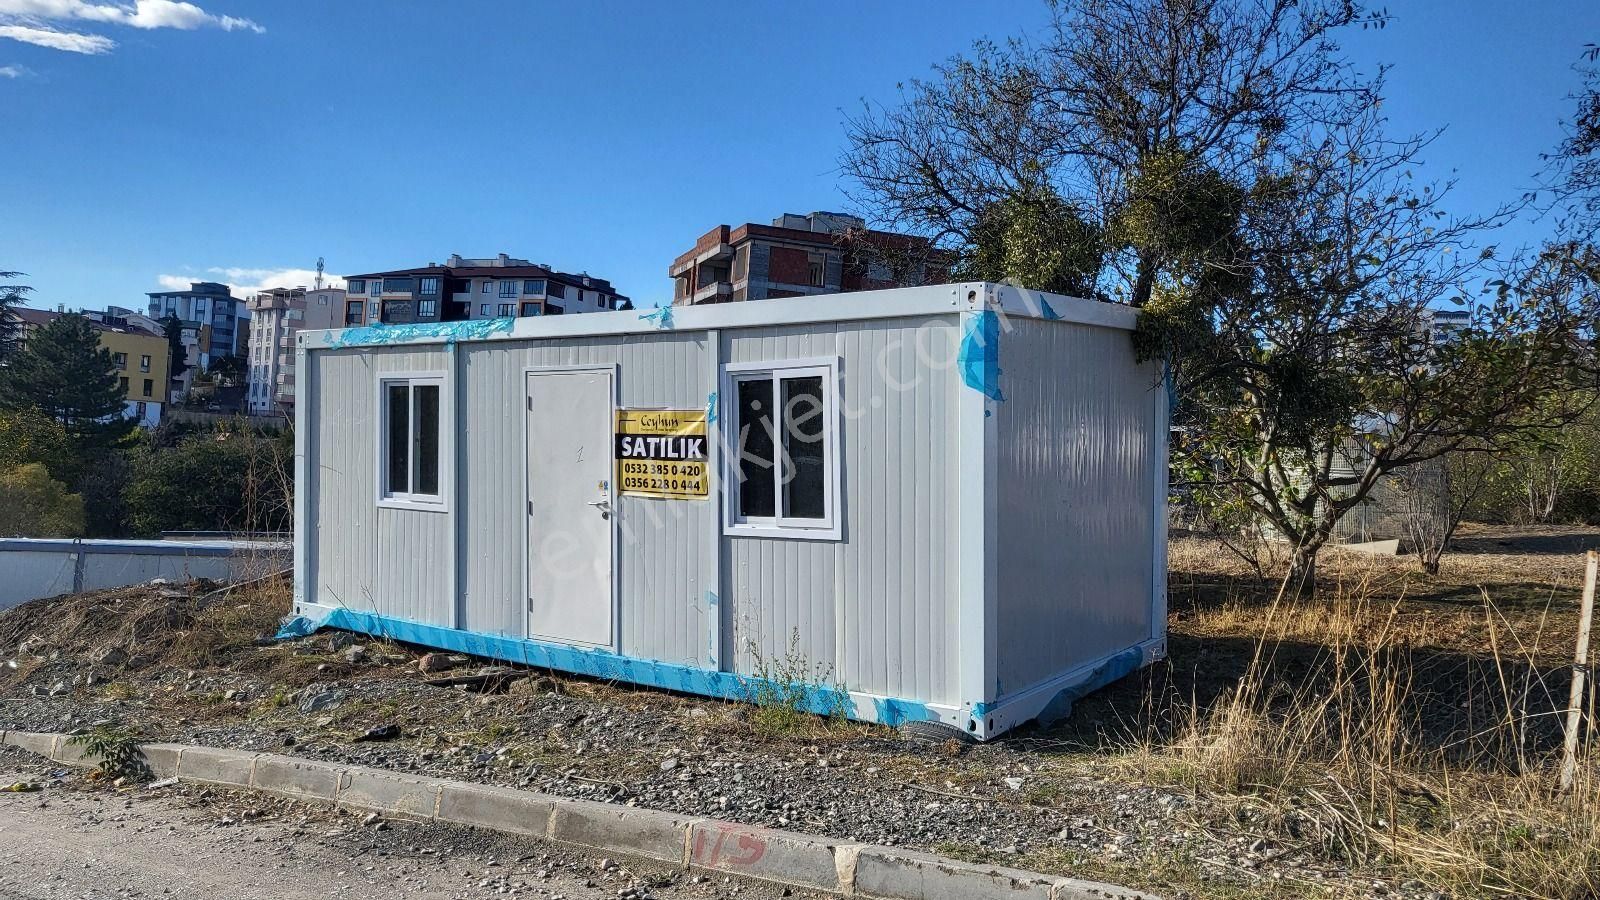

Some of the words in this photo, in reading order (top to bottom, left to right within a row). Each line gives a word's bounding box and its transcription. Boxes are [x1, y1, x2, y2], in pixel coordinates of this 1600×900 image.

[640, 414, 679, 430] Ceyhun
[621, 436, 703, 459] SATILIK
[624, 463, 648, 474] 0532
[650, 464, 669, 475] 385
[671, 465, 678, 476] 0
[680, 466, 700, 476] 420
[624, 477, 649, 488] 0356
[651, 479, 669, 490] 228
[671, 480, 678, 490] 0
[680, 480, 701, 491] 444
